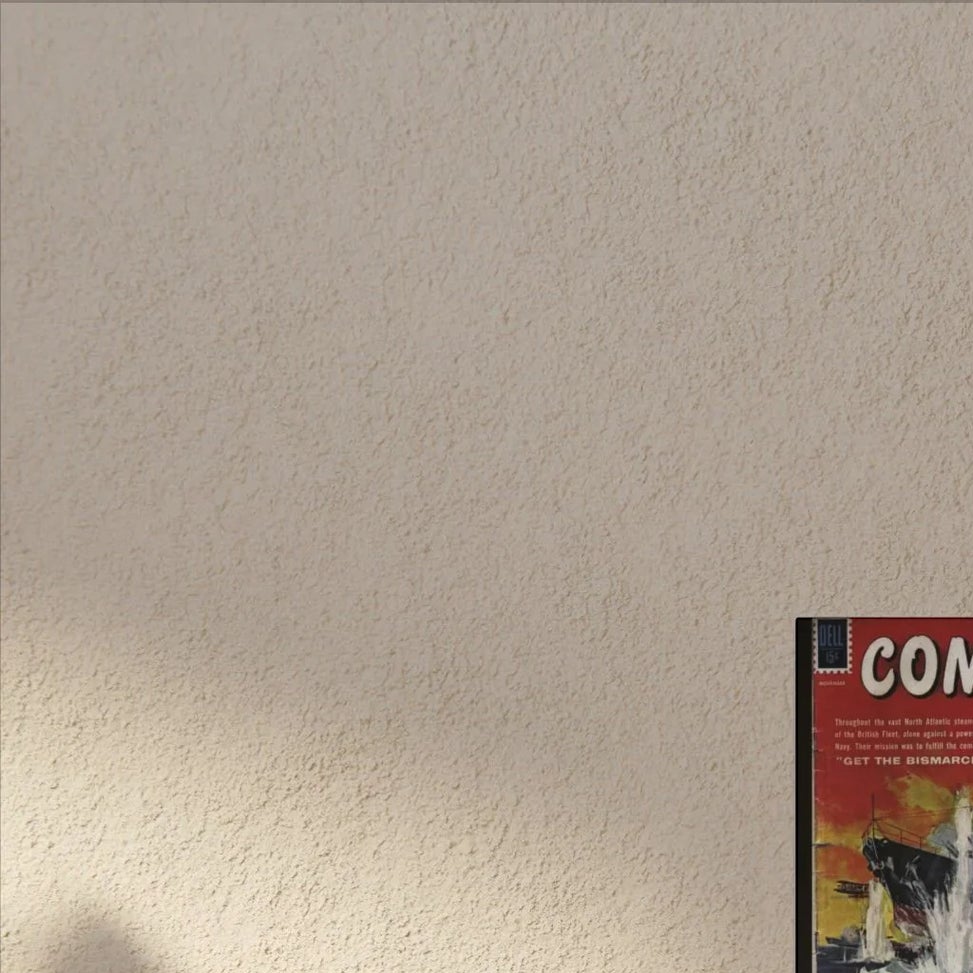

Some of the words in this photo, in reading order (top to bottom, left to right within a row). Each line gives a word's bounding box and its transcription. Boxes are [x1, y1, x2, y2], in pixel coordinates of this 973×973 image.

[820, 624, 843, 646] DELL
[835, 718, 871, 727] Throughout
[875, 718, 885, 726] the
[923, 730, 946, 739] against
[874, 757, 901, 765] THE
